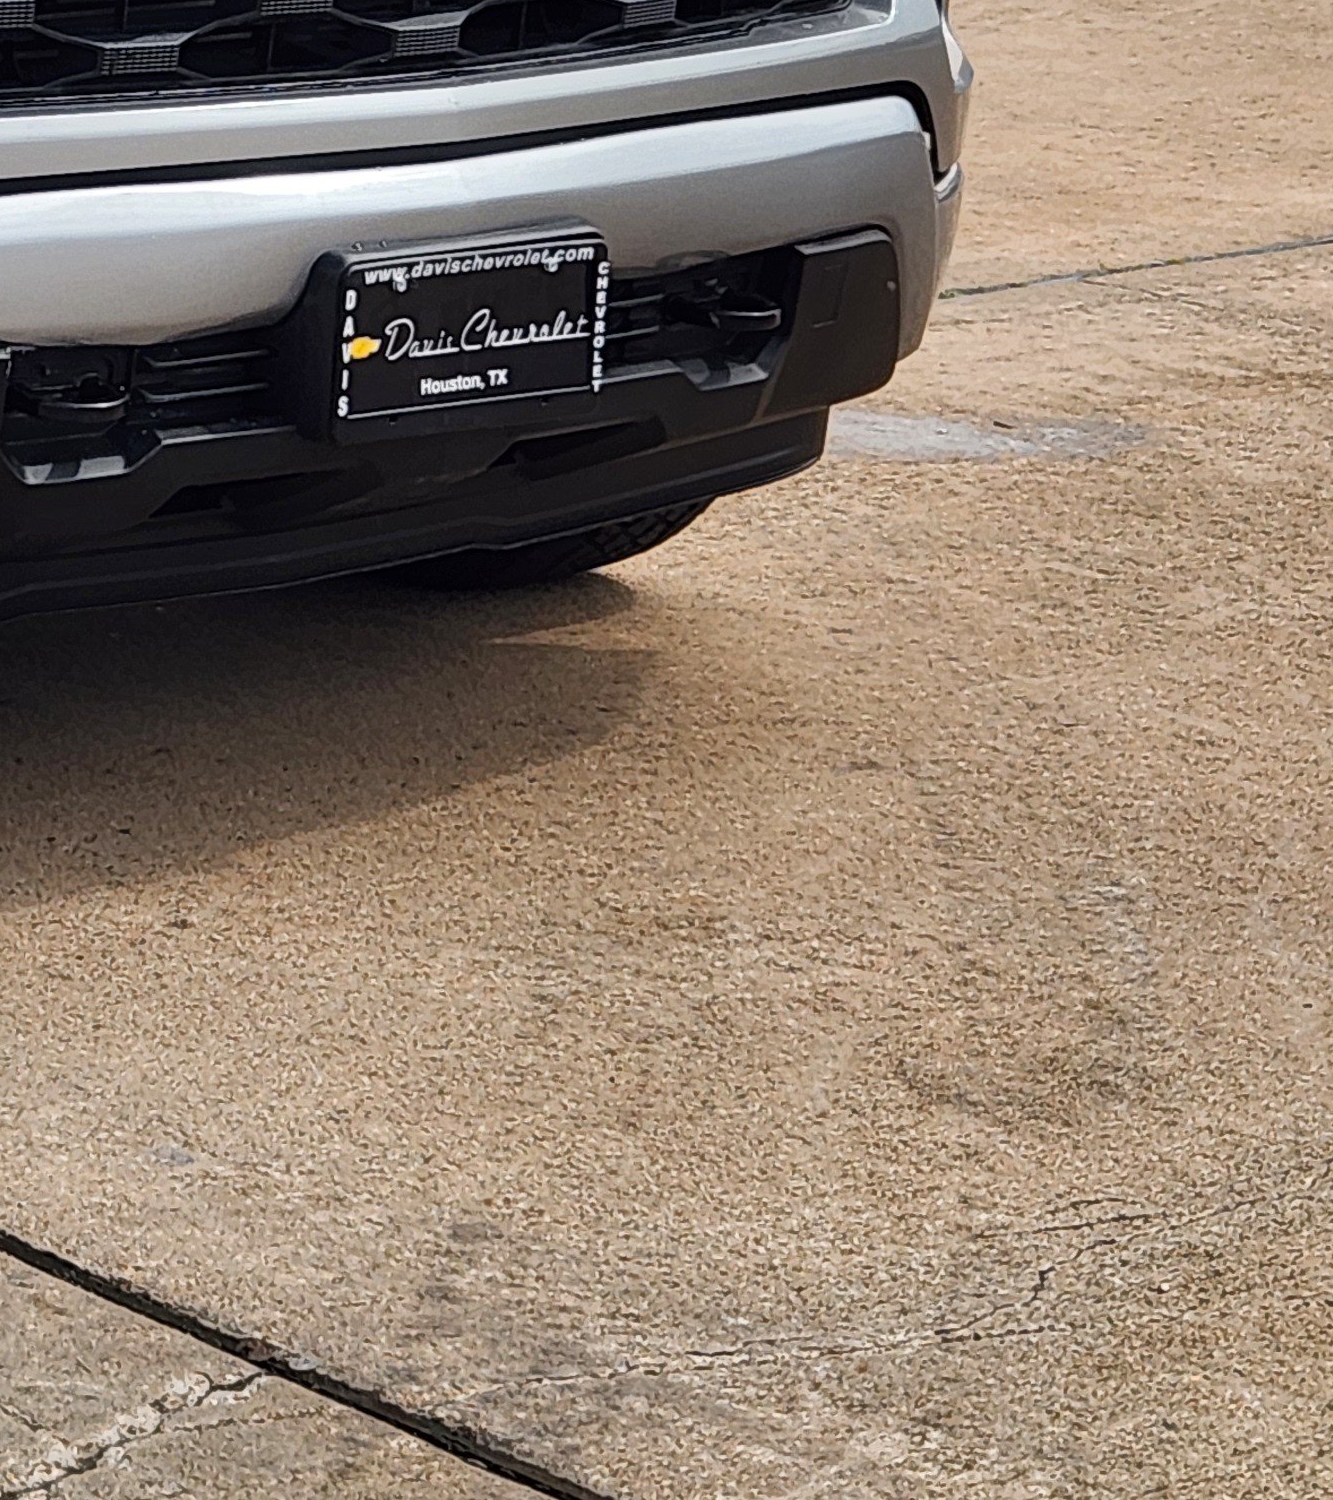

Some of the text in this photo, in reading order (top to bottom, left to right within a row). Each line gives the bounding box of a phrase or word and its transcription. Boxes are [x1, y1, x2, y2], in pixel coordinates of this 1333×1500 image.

[365, 246, 595, 286] www.davischevrolet.com
[336, 288, 358, 418] DAVIS
[384, 308, 591, 361] Davis Chevrolet
[592, 261, 610, 392] CHEVROLET
[420, 368, 508, 396] Houston, TX
